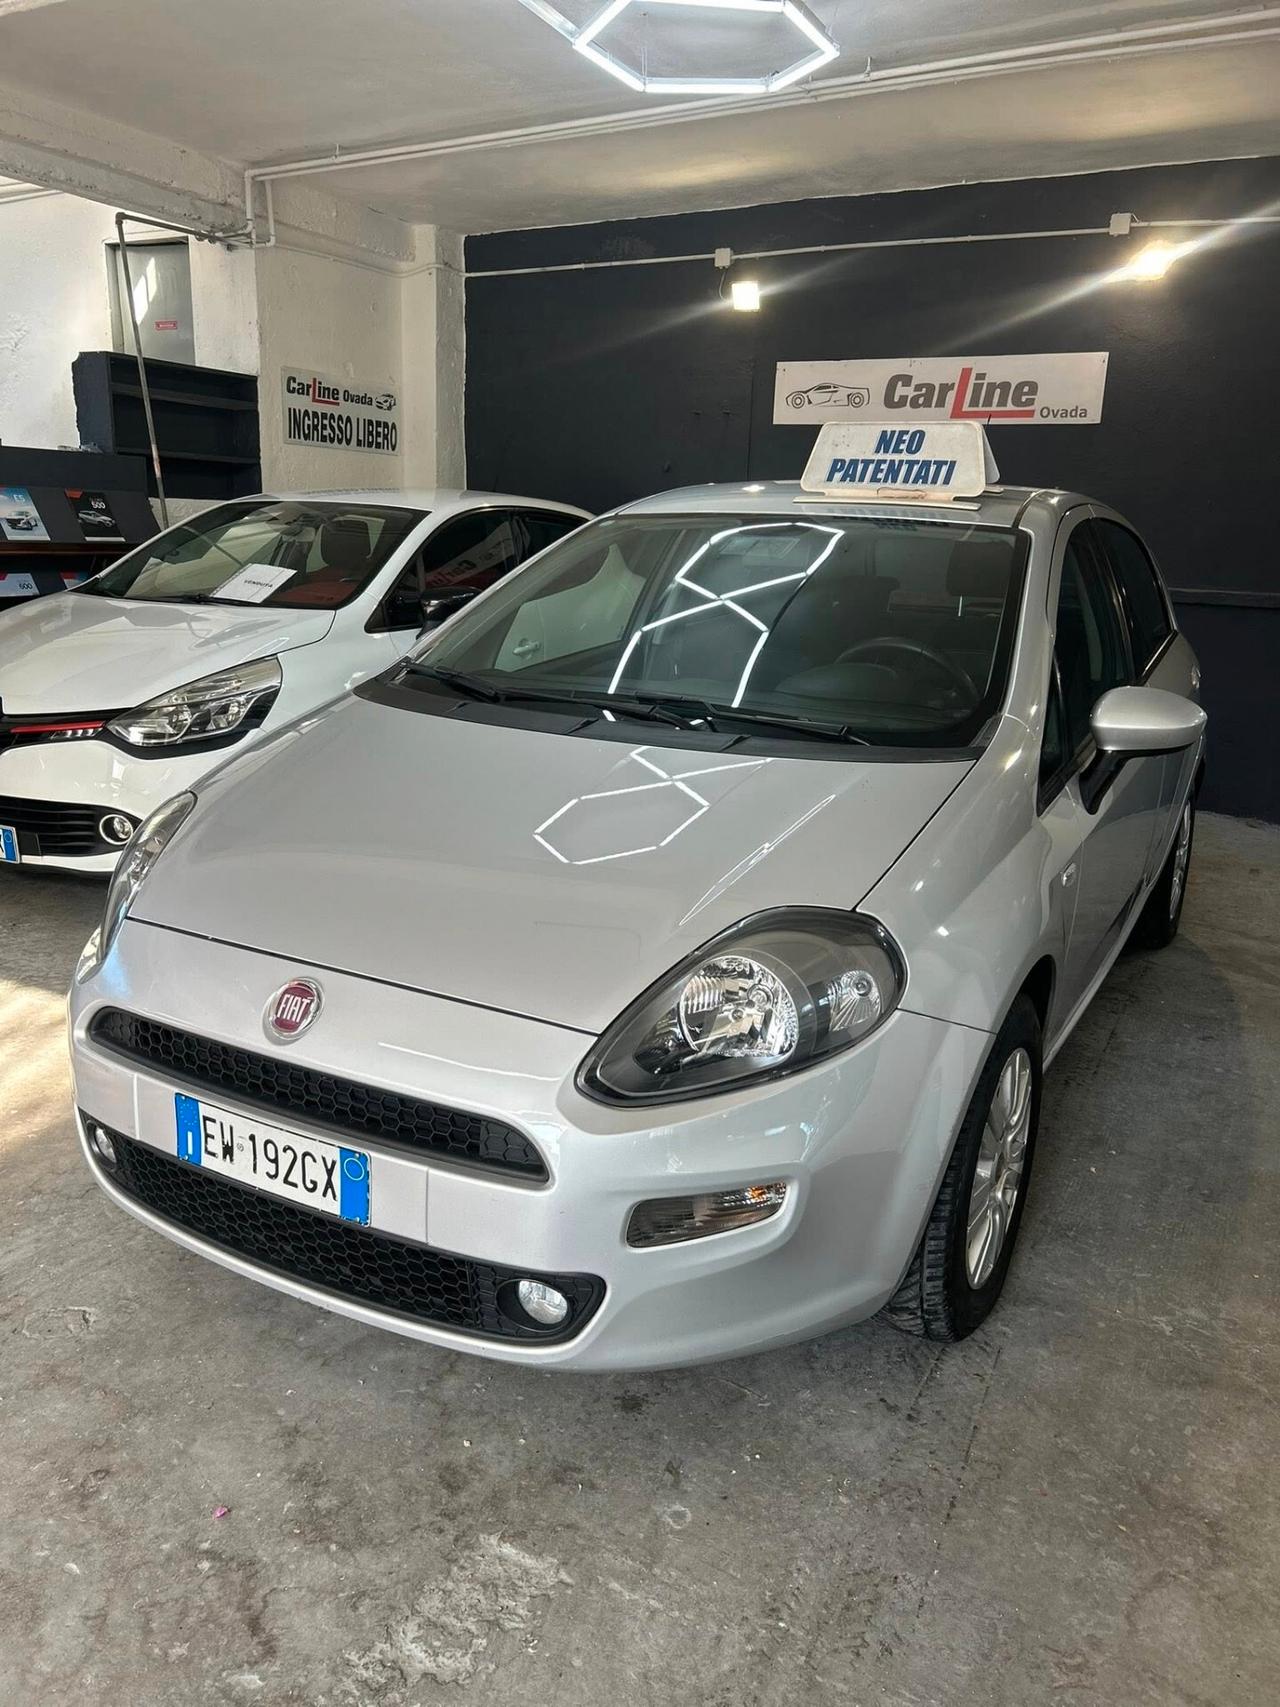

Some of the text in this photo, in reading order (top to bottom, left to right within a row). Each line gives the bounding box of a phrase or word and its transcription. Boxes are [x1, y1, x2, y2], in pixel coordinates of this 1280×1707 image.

[343, 390, 373, 406] Ovada
[1039, 405, 1088, 418] Ovada
[288, 407, 397, 451] INGRESSO LIBERO
[874, 429, 926, 454] NEO
[826, 458, 957, 485] PATENTATI
[277, 993, 311, 1023] FIAT
